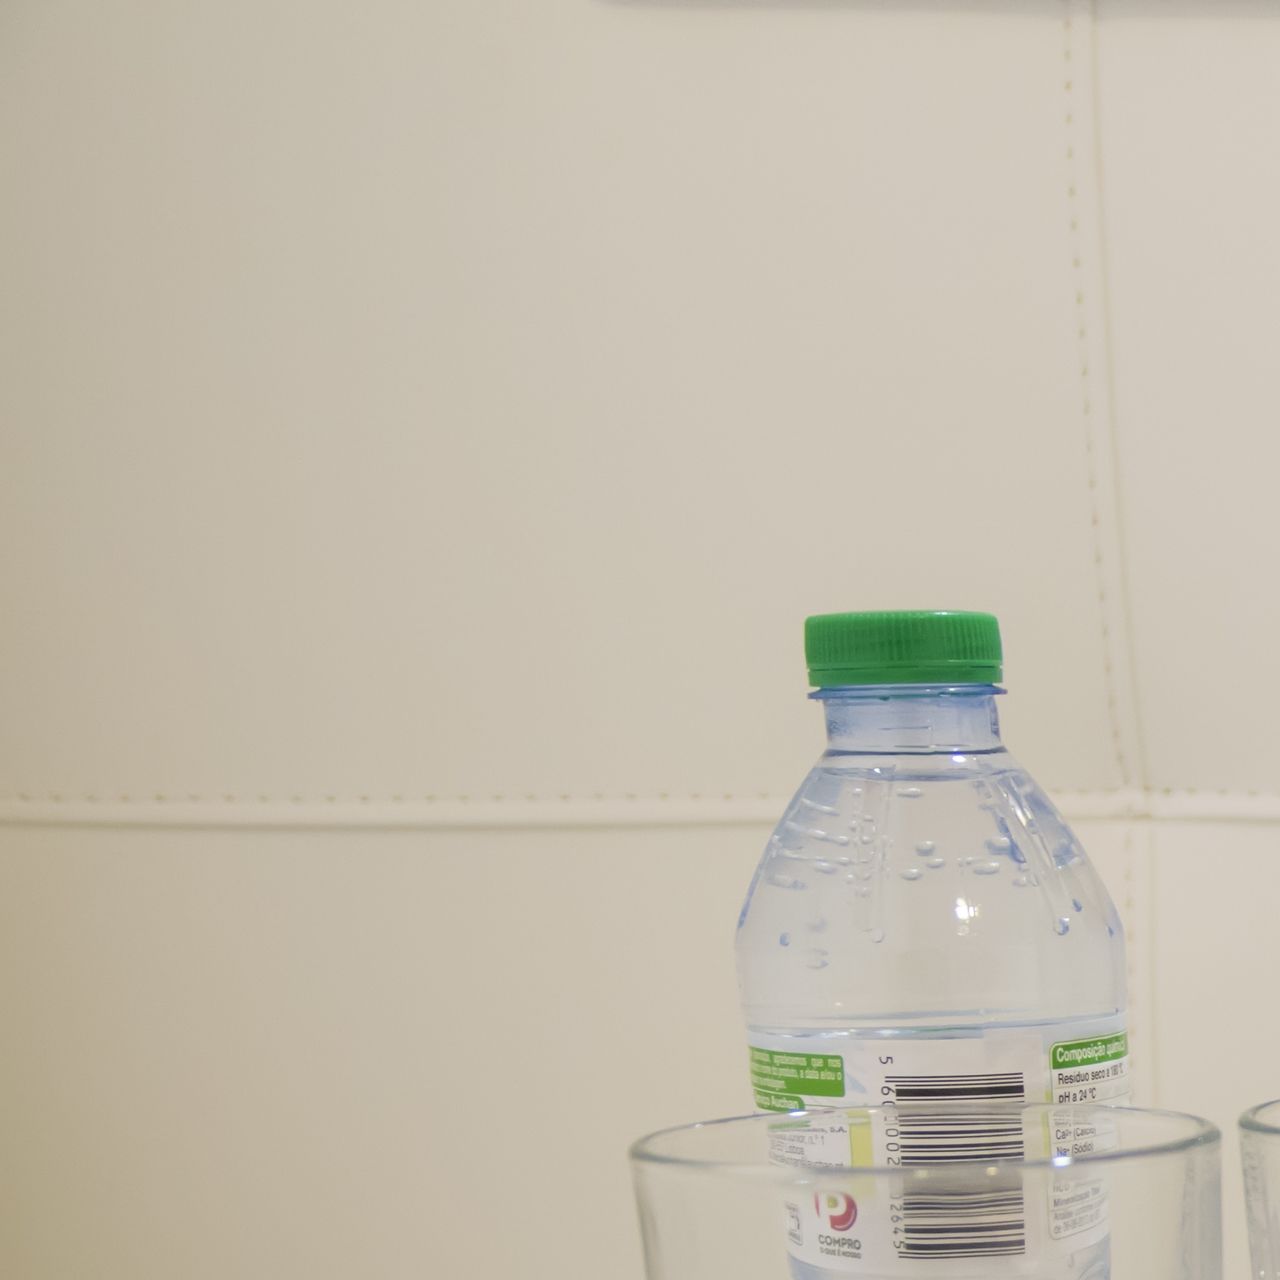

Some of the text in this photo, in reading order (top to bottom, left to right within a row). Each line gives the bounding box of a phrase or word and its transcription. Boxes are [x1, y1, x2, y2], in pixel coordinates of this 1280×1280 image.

[1056, 1042, 1106, 1063] Composição
[879, 1056, 893, 1064] 5
[1091, 1069, 1105, 1081] seco
[1058, 1091, 1071, 1103] pH
[1072, 1093, 1077, 1103] a
[1079, 1089, 1087, 1101] 24
[818, 1234, 862, 1251] COMPRO
